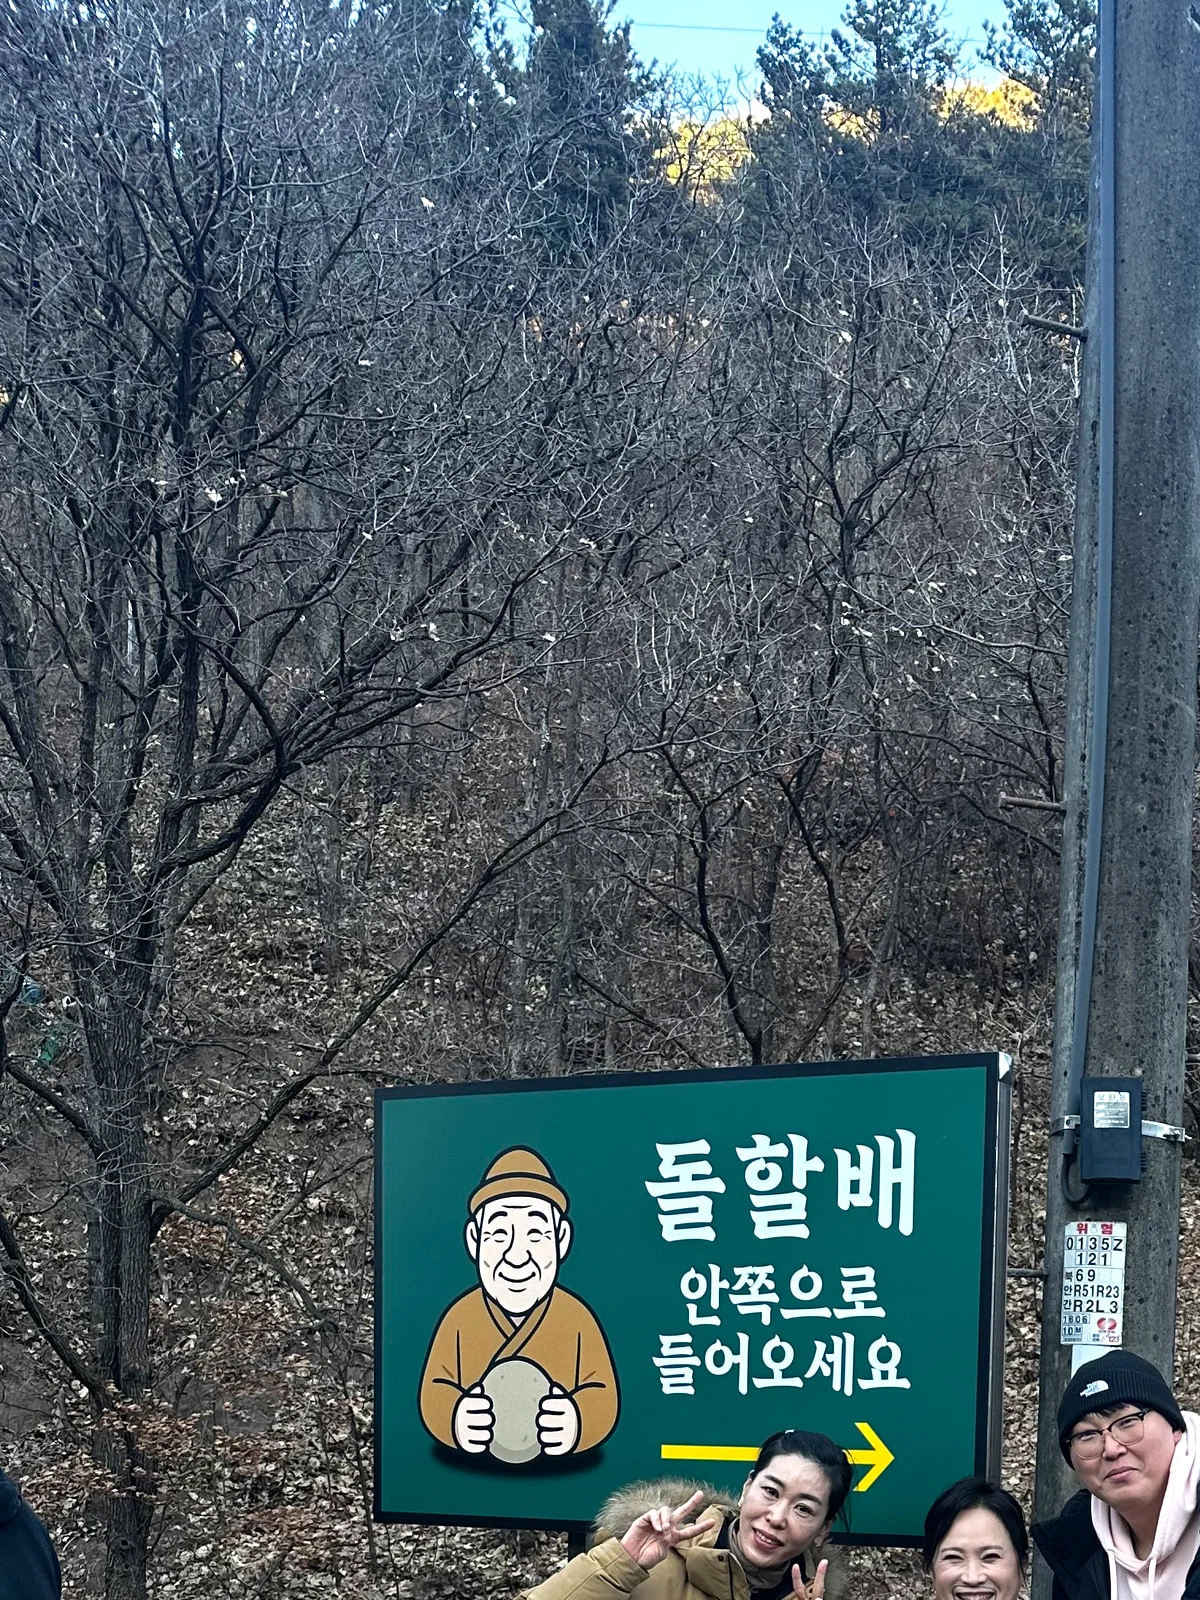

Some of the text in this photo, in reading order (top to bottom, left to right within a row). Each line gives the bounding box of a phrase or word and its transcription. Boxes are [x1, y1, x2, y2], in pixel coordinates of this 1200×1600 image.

[645, 1129, 916, 1242] 돌할배
[1066, 1237, 1123, 1252] 0135Z
[1077, 1252, 1107, 1266] 121
[680, 1263, 886, 1326] 안쪽으로
[653, 1331, 911, 1397] 들어오세요
